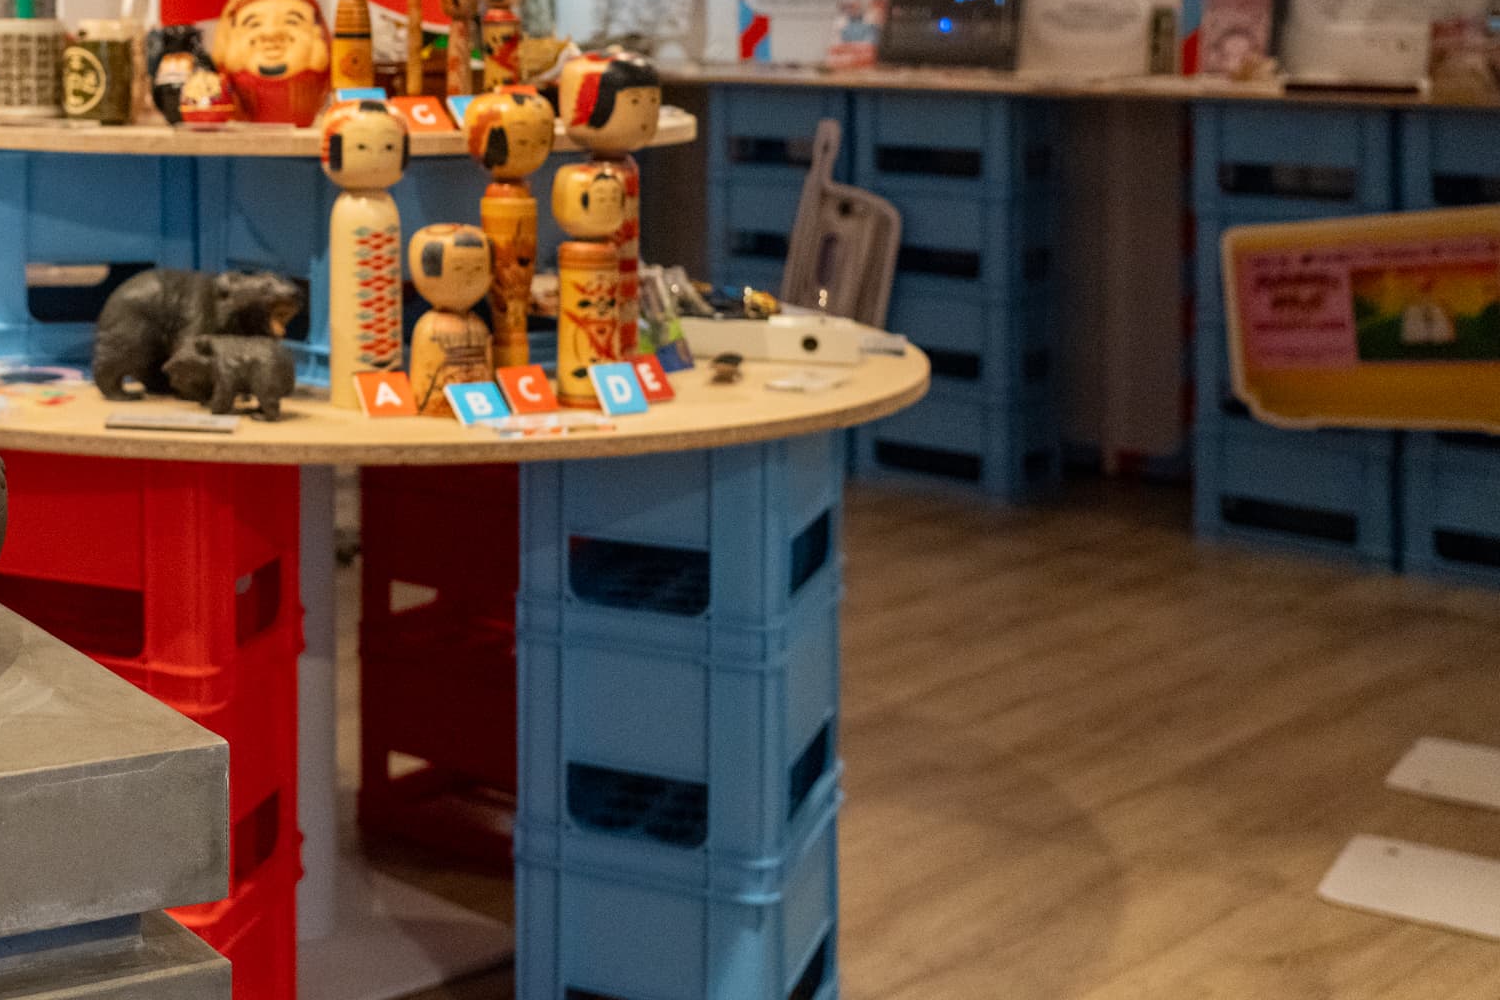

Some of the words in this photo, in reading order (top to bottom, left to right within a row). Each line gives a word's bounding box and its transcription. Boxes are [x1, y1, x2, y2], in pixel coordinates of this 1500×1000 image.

[518, 376, 542, 402] C
[606, 374, 633, 404] D
[636, 363, 662, 392] E
[375, 381, 402, 406] A
[466, 390, 493, 416] B
